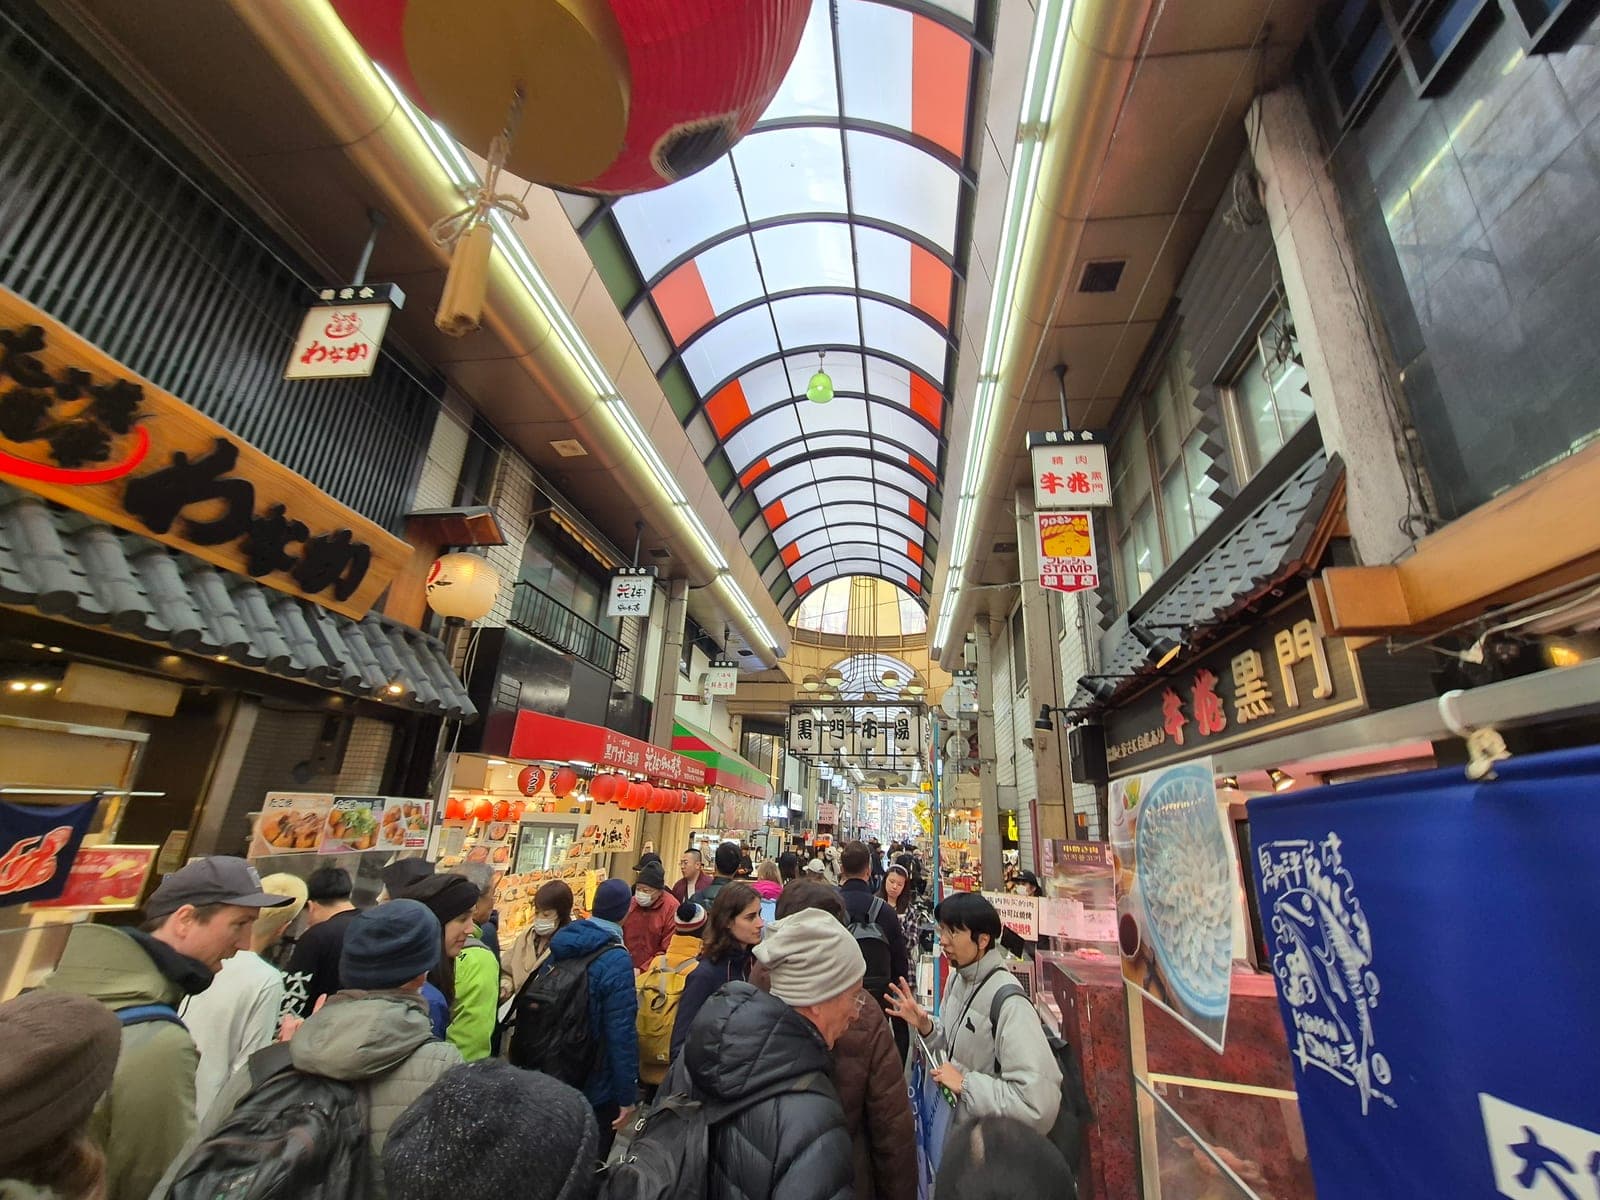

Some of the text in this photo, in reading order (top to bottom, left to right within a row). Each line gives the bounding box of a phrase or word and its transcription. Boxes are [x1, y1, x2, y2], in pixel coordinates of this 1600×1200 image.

[301, 341, 369, 364] わなか
[124, 437, 371, 602] わなか
[1043, 564, 1093, 574] STAMP
[797, 718, 910, 742] 黒門市場
